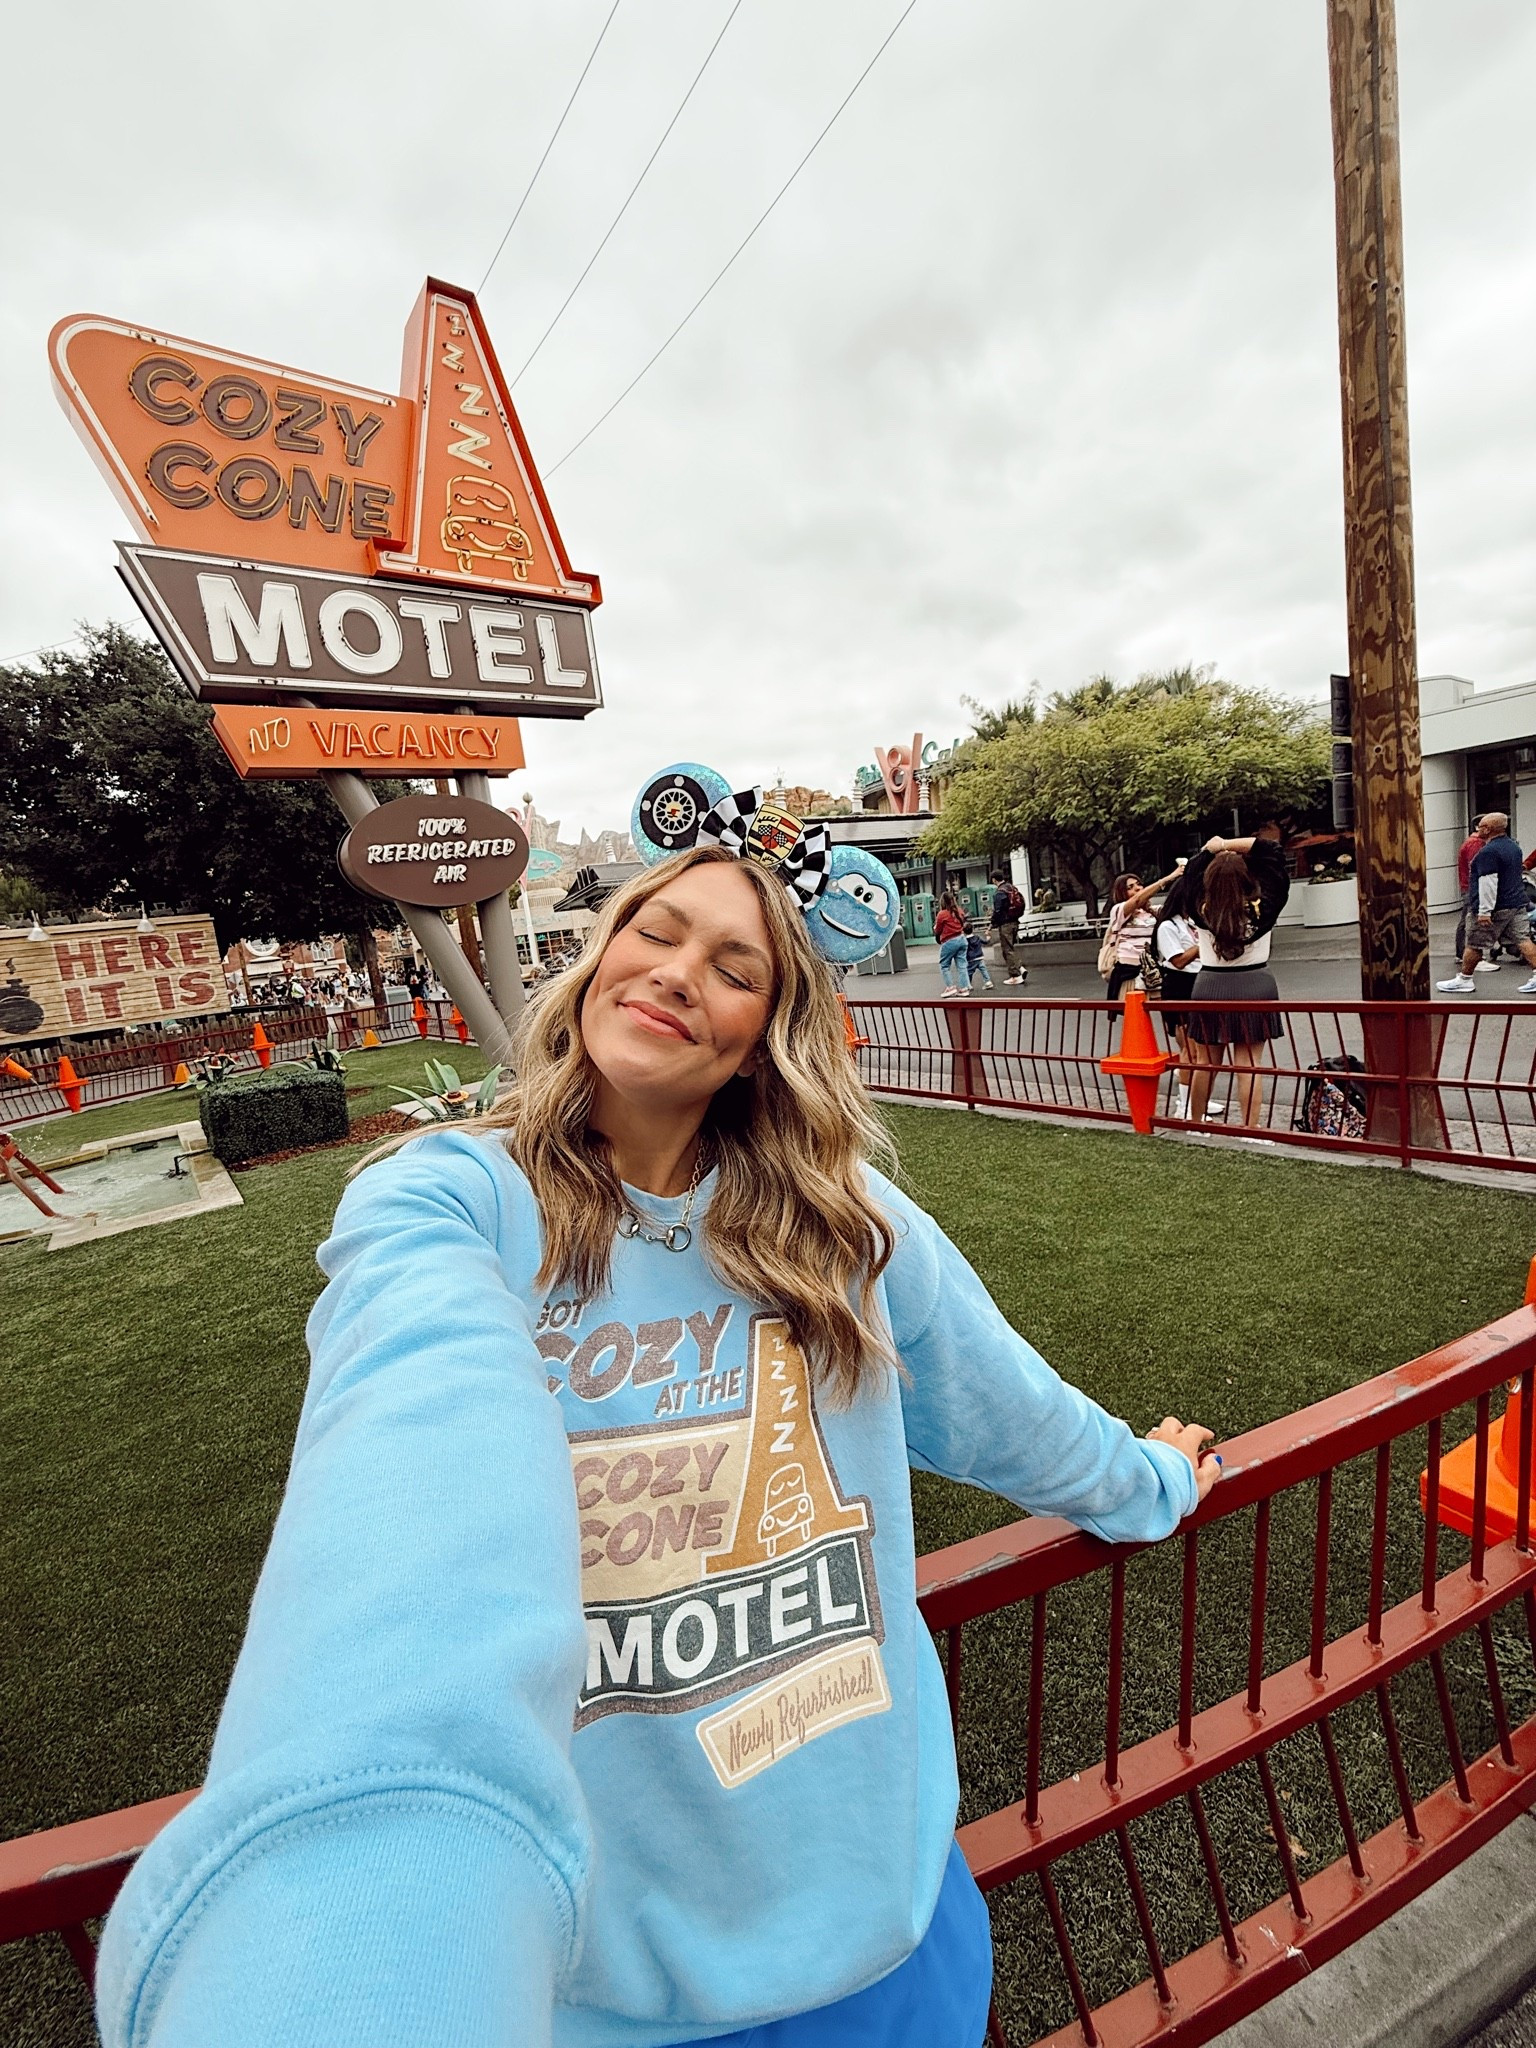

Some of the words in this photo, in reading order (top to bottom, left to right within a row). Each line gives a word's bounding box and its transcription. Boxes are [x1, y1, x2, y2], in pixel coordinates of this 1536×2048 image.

[128, 351, 384, 467] COZY
[145, 439, 395, 539] CONE
[197, 572, 587, 687] MOTEL
[250, 717, 291, 755] NO
[307, 720, 501, 759] VACANCY
[417, 817, 468, 838] 100%
[432, 864, 468, 884] AIR
[53, 930, 211, 981] HERE
[64, 981, 126, 1026] IT
[154, 970, 215, 1011] IS
[653, 1379, 692, 1418] AT
[693, 1365, 745, 1409] THE
[573, 1441, 730, 1511] COZY
[580, 1500, 731, 1569] CONE
[584, 1556, 857, 1690] MOTEL
[729, 1708, 776, 1771] Newly
